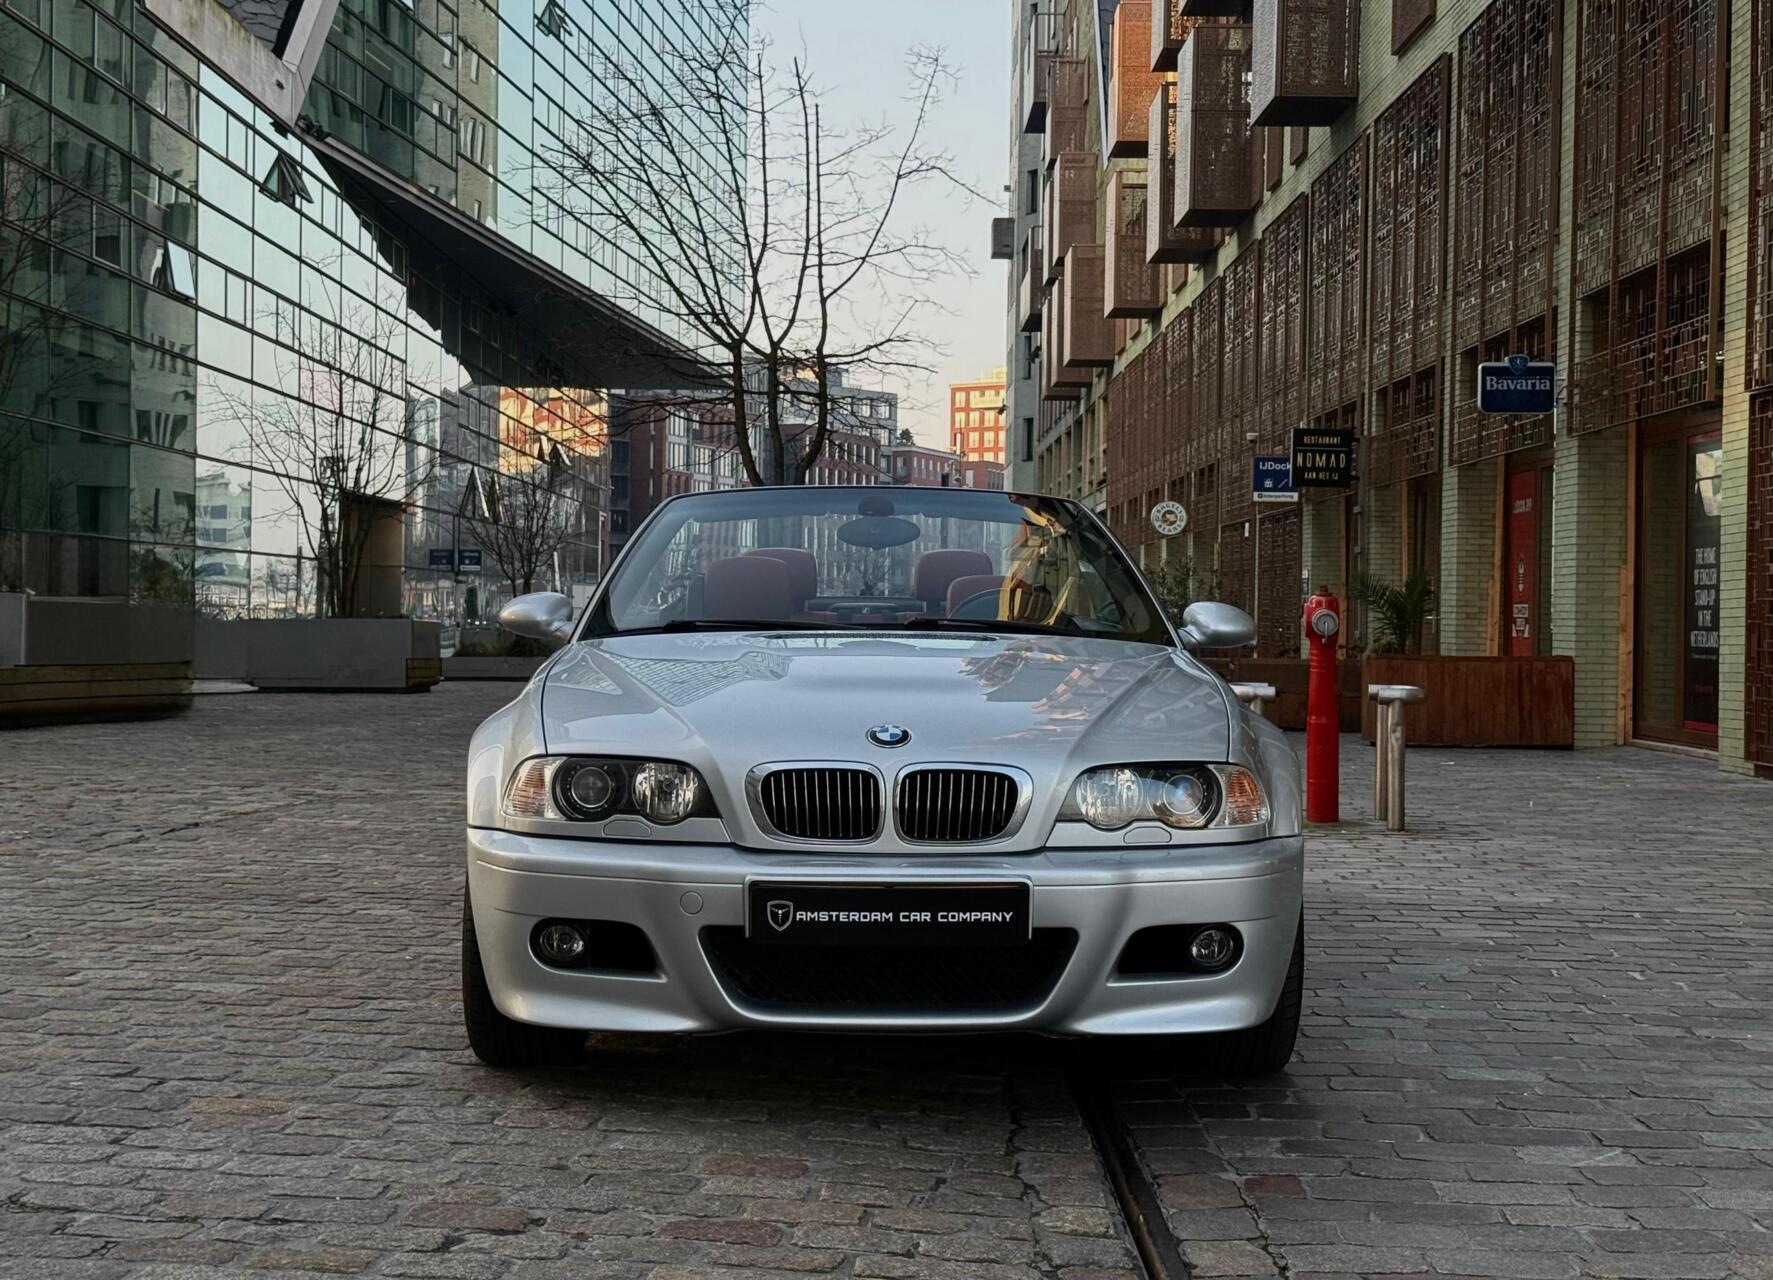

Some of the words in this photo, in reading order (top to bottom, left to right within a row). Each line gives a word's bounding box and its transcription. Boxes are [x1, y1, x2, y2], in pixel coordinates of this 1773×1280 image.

[1486, 376, 1551, 391] Bavaria
[1303, 435, 1341, 445] RESTAURANT
[1297, 452, 1346, 468] NOMAD
[796, 911, 894, 922] AMSTERDAM
[899, 911, 932, 922] CAR
[937, 911, 1014, 922] COMPANY
